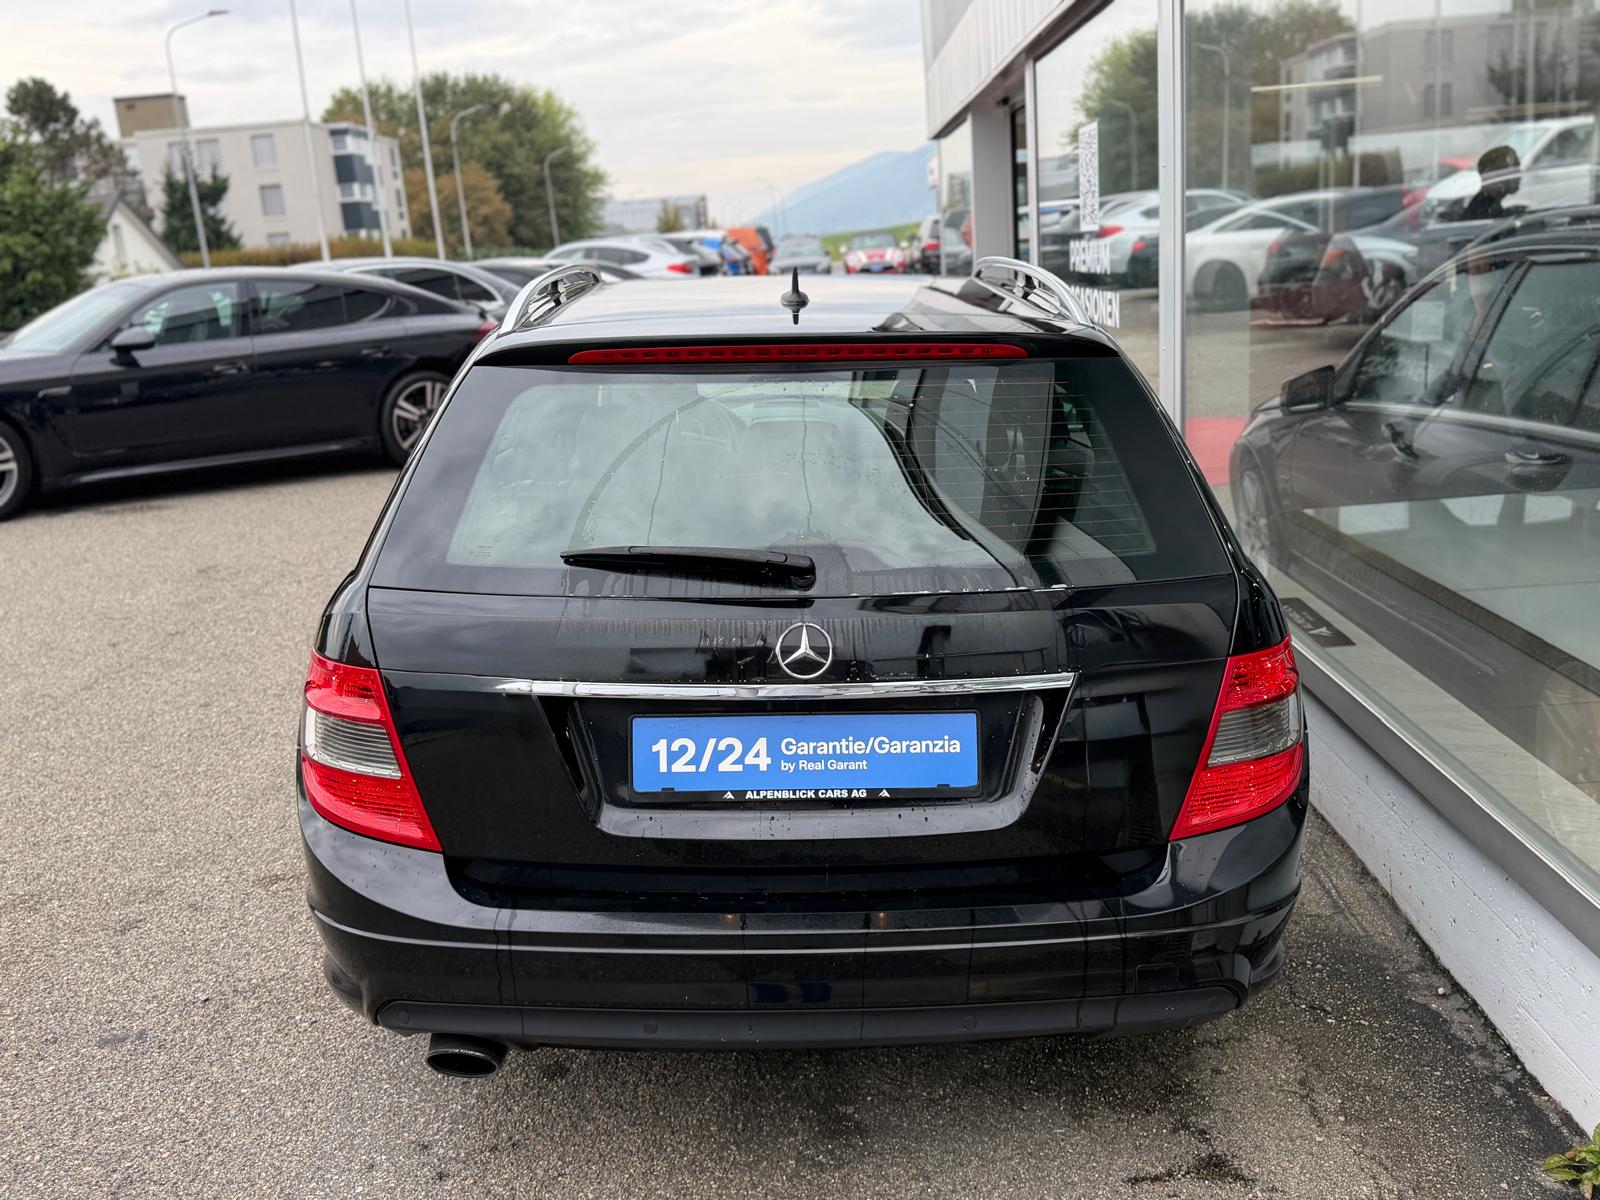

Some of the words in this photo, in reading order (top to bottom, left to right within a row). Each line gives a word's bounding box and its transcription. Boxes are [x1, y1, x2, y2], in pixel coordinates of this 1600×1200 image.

[1069, 240, 1110, 275] PREMIUM
[651, 736, 772, 773] 12/24
[780, 735, 961, 756] Garantie/Garanzia
[780, 760, 796, 773] by
[799, 759, 825, 771] Real
[827, 759, 868, 770] Garant
[745, 789, 816, 800] ALPENBLICK
[818, 789, 849, 798] CARS
[851, 789, 868, 798] AG
